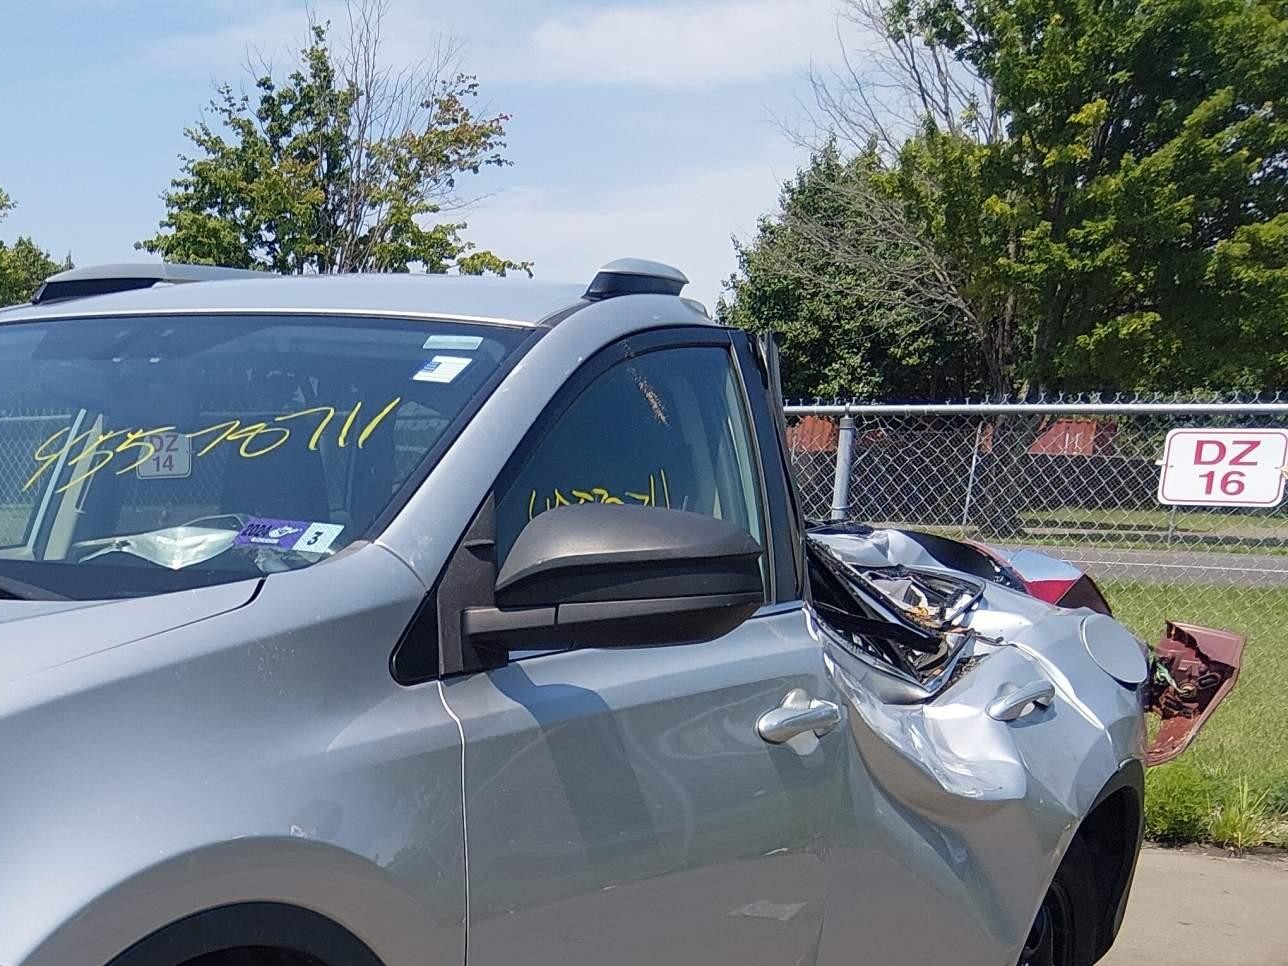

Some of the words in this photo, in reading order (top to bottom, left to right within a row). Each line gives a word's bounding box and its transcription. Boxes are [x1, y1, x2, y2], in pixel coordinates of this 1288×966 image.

[153, 454, 175, 472] 14
[1193, 440, 1261, 466] DZ
[1198, 470, 1246, 496] 16
[307, 531, 323, 546] 3
